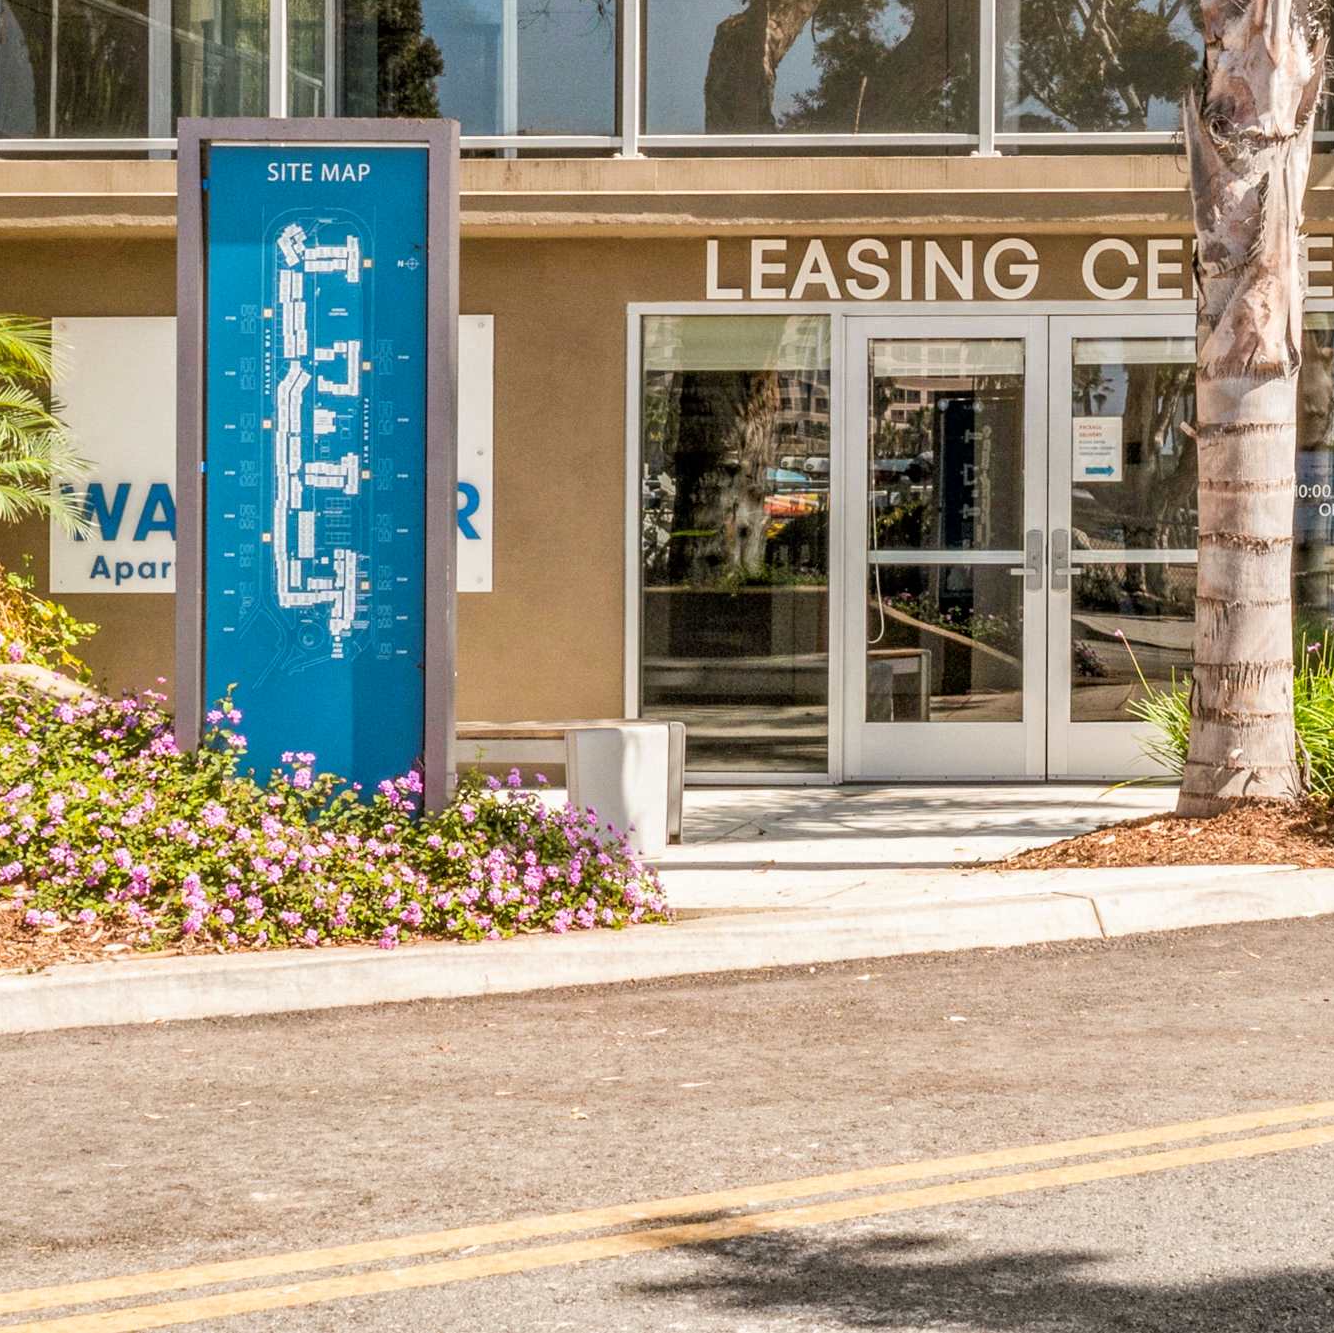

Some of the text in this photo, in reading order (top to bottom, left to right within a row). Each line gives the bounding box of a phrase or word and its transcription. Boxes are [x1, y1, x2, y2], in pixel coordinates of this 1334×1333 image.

[267, 162, 371, 182] SITE MAP
[705, 237, 1040, 301] LEASING
[1294, 484, 1331, 498] 10:00
